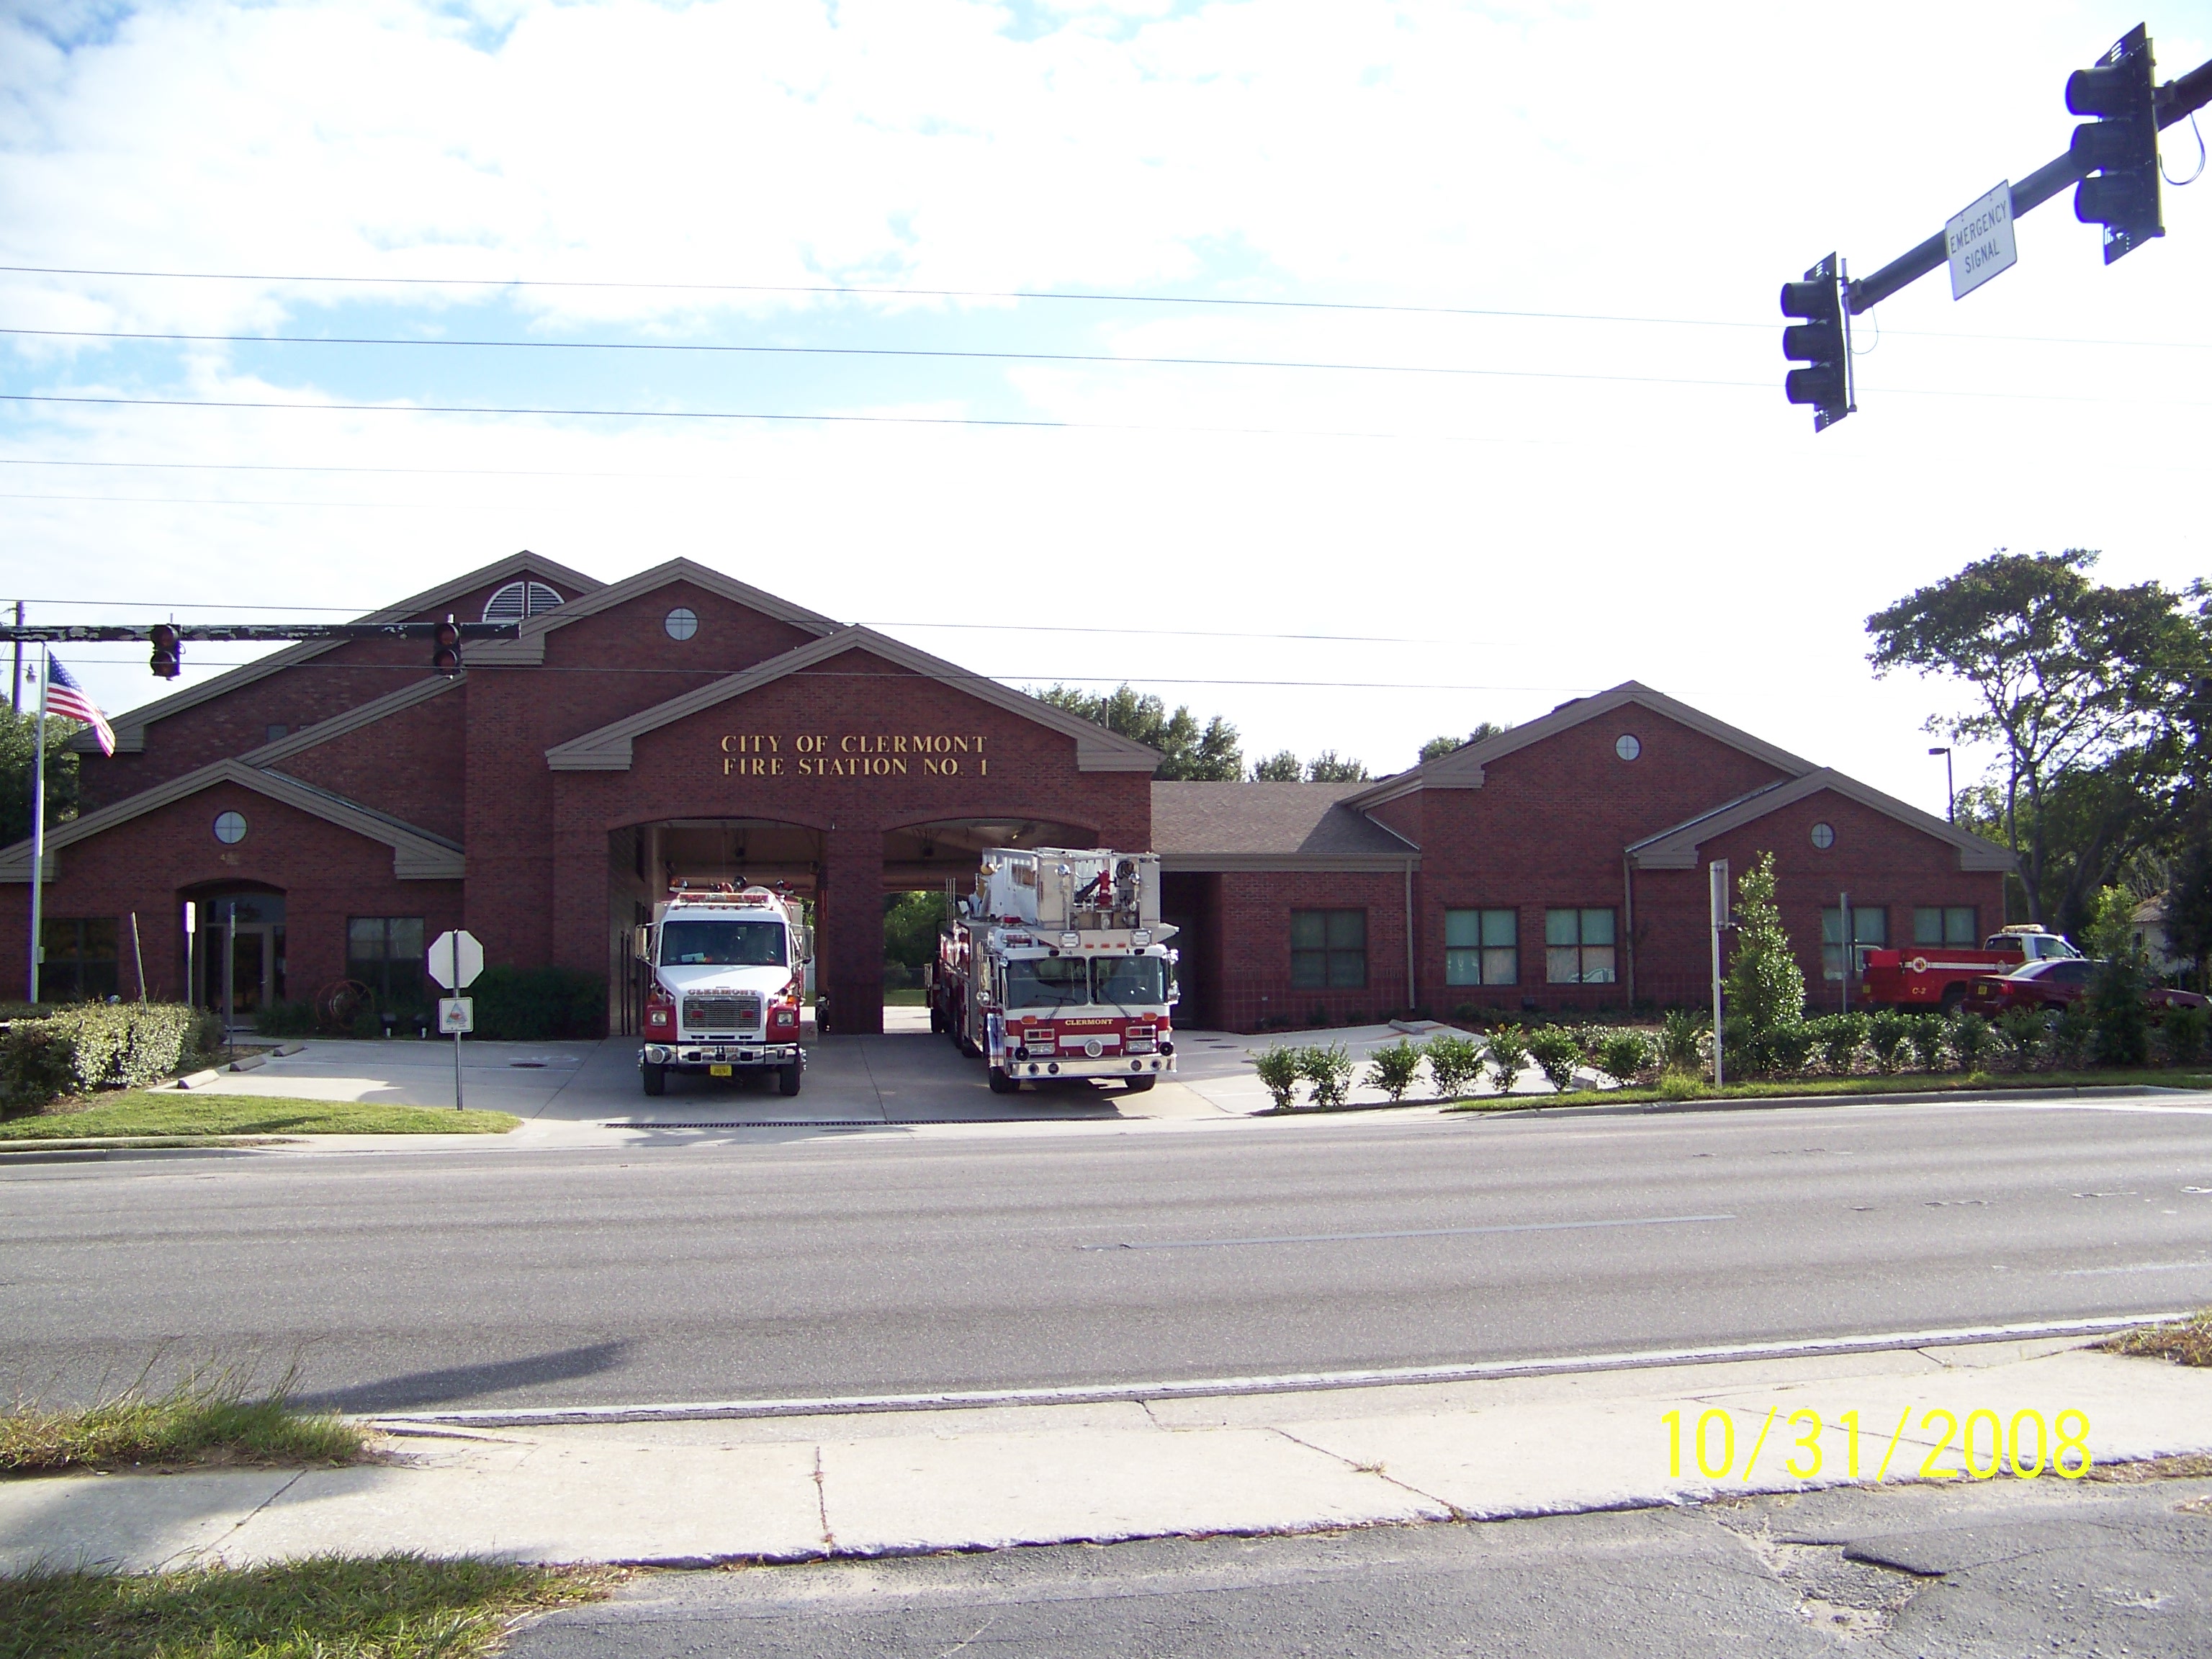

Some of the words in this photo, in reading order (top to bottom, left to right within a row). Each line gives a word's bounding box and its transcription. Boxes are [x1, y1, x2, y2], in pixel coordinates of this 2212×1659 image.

[1950, 200, 2007, 254] EMERGENCY
[1965, 238, 2000, 274] SIGNAL
[721, 735, 782, 753] CITY
[796, 735, 828, 752] OF
[841, 735, 987, 753] CLERMONT
[724, 758, 784, 775] FIRE
[799, 758, 908, 775] STATION
[924, 758, 965, 775] NO.
[981, 759, 988, 775] 1
